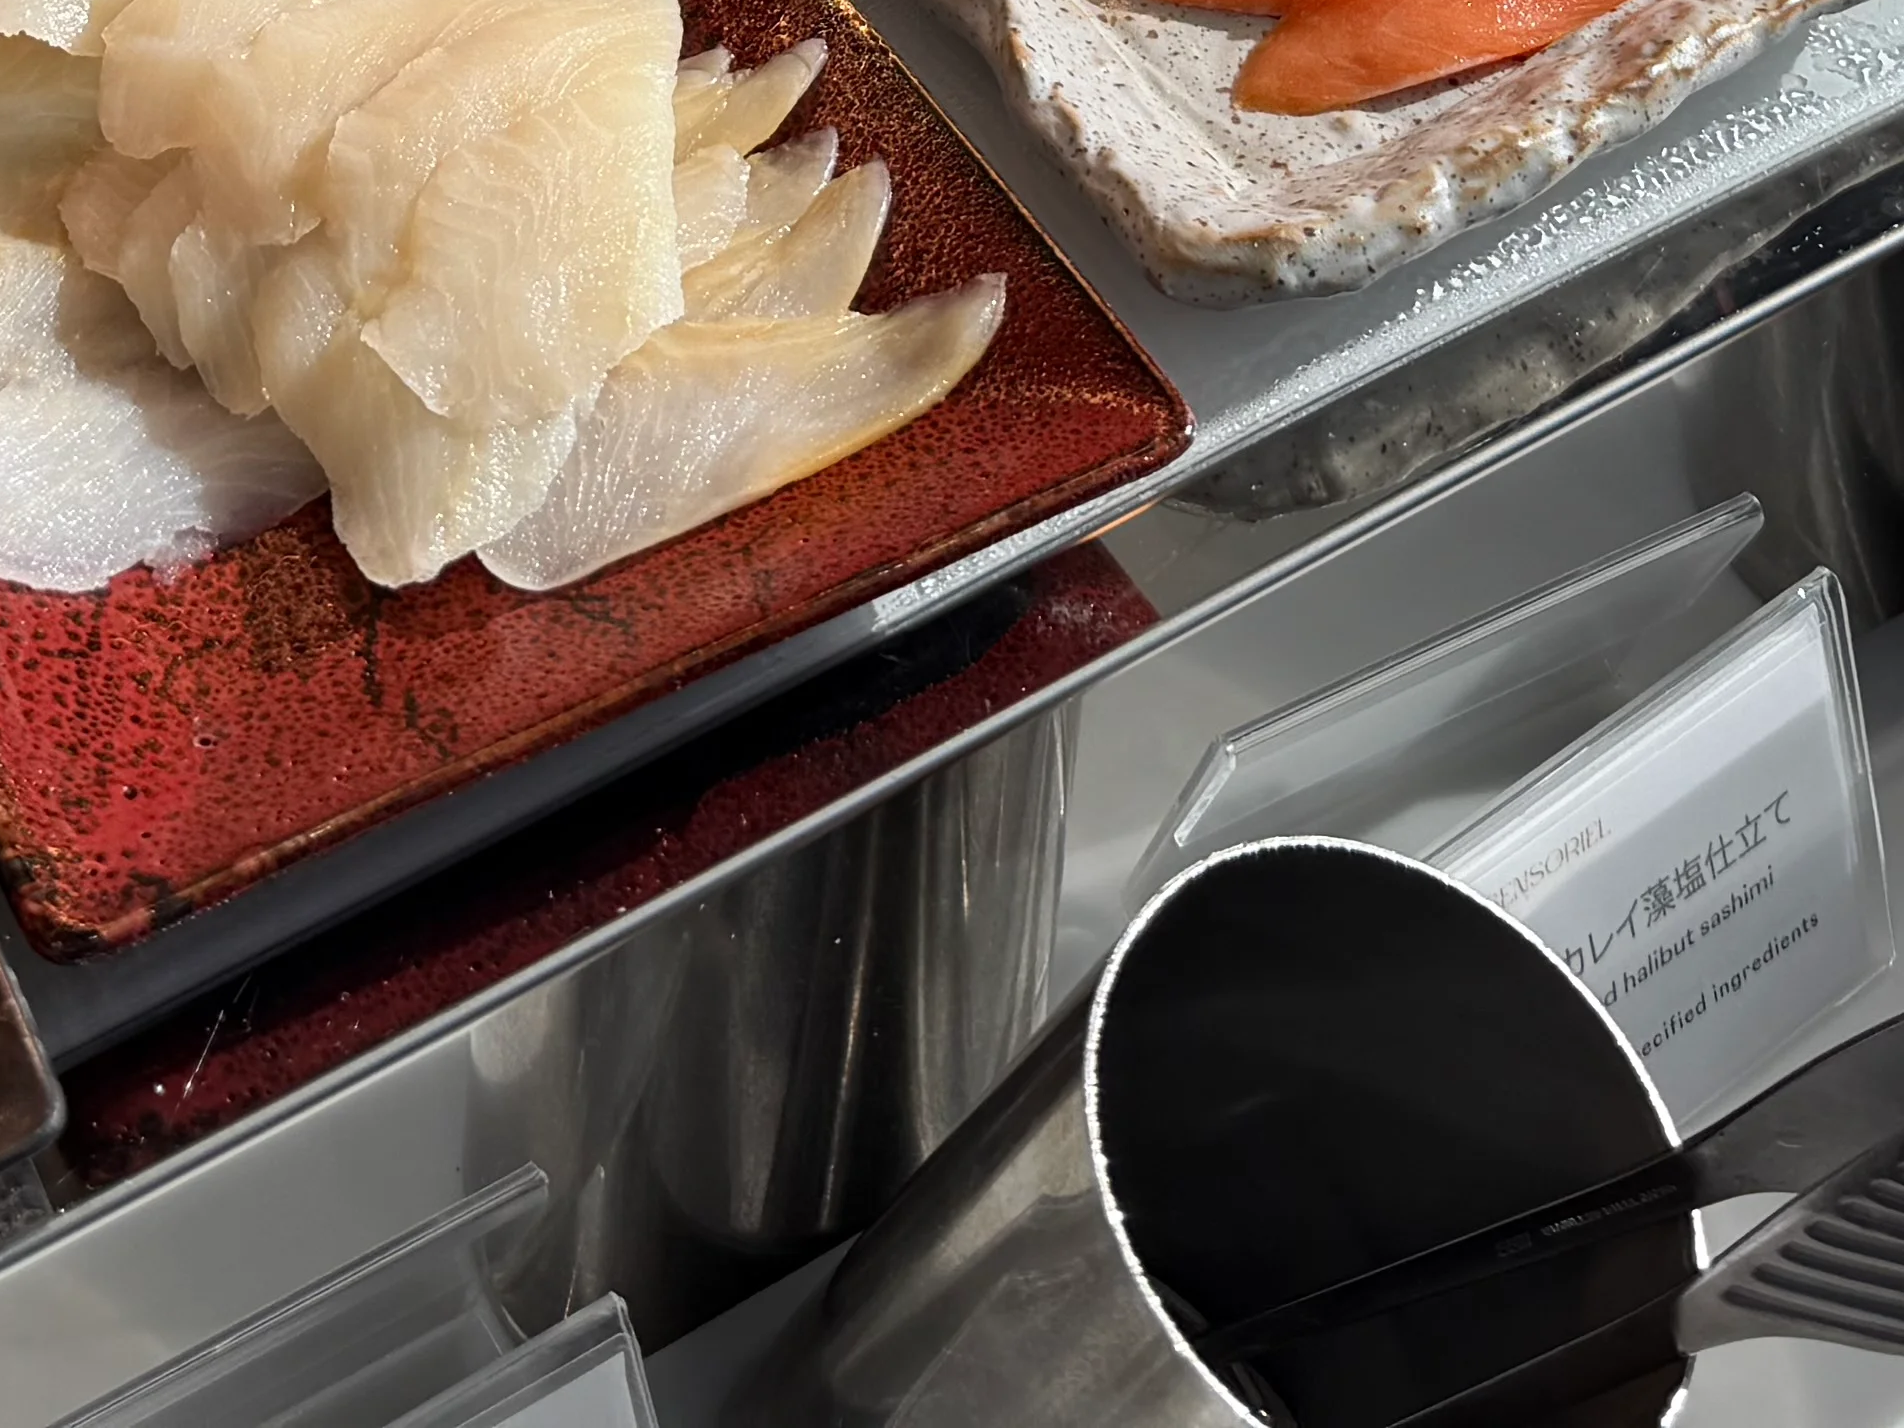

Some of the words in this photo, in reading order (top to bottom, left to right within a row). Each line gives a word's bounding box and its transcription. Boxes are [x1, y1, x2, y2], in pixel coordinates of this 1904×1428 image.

[1622, 929, 1696, 990] halibut
[1699, 864, 1775, 938] sashimi
[1636, 994, 1709, 1058] ecified
[1712, 912, 1821, 1004] ingredients
